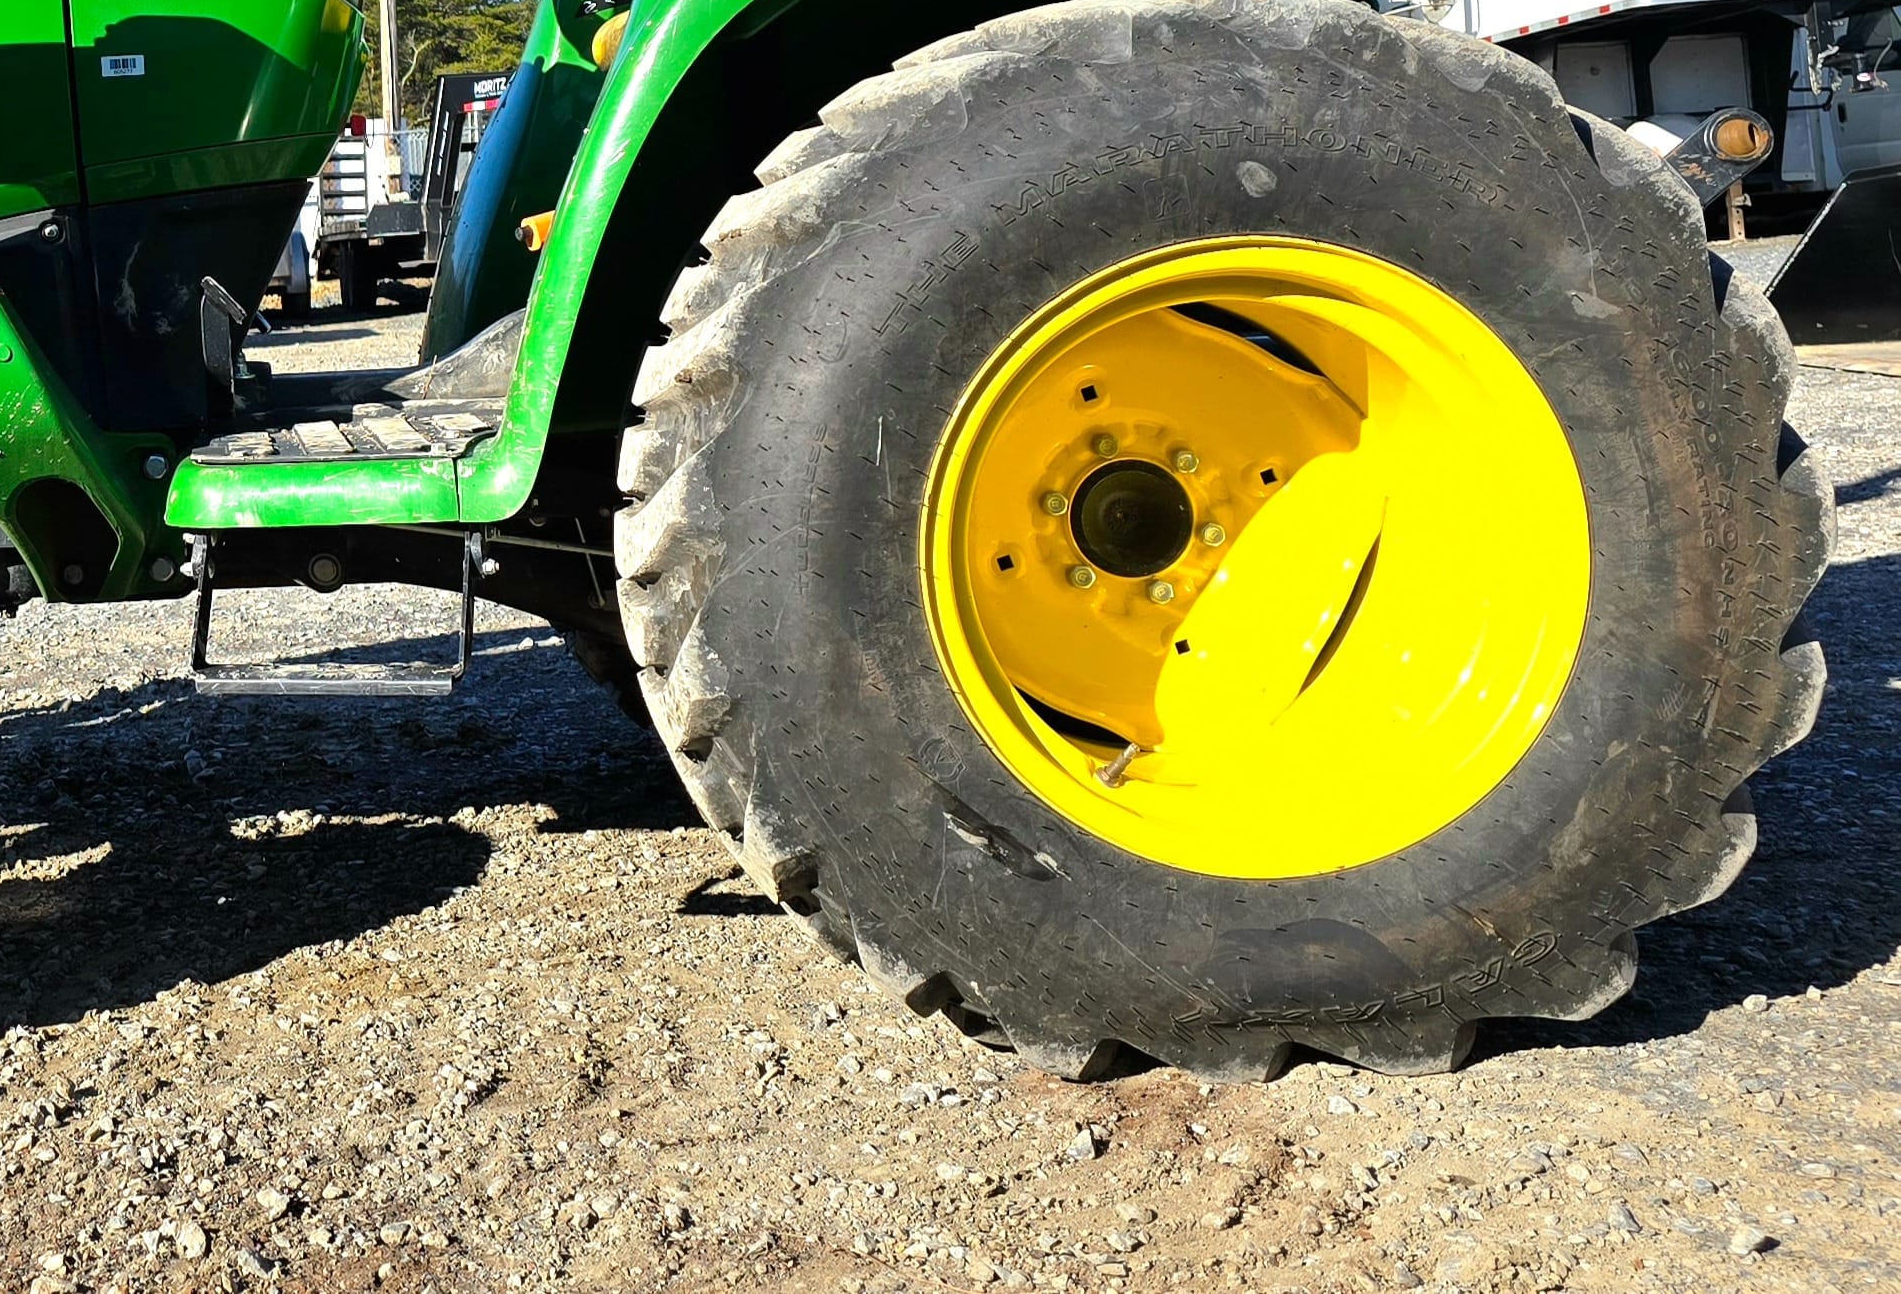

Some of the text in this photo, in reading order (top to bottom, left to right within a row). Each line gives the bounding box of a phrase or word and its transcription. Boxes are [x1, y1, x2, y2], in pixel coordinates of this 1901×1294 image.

[473, 77, 507, 94] MORITZ
[871, 122, 1502, 338] THE MARATHONER
